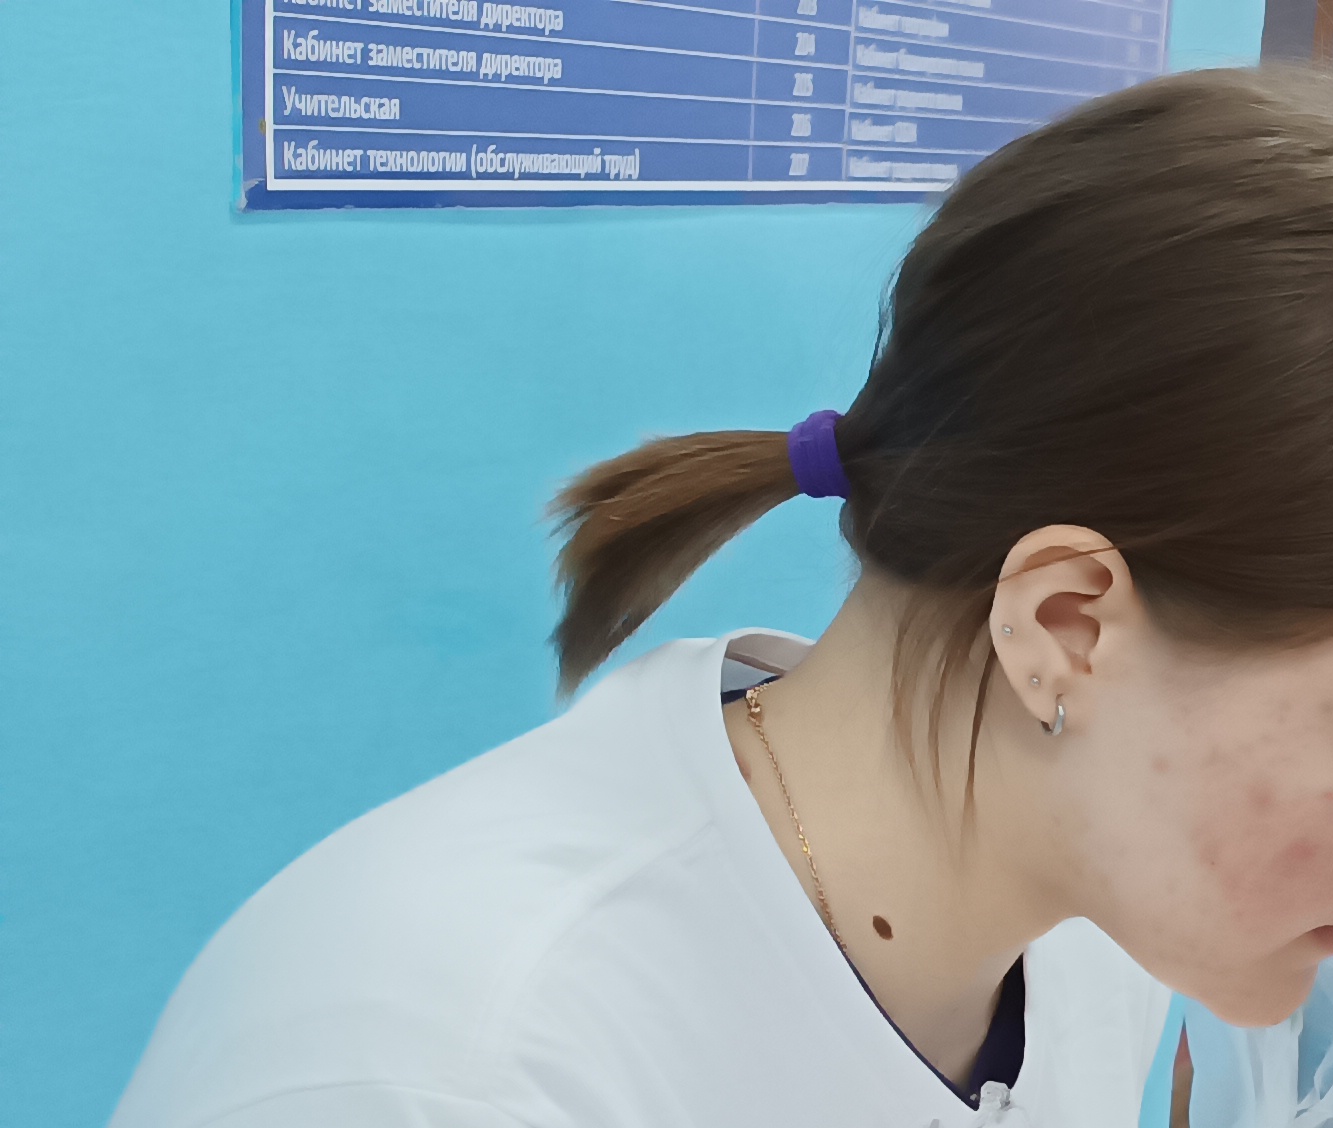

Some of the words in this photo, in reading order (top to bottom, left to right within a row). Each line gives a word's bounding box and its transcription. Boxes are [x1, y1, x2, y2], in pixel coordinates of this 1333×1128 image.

[479, 4, 564, 33] директора
[282, 29, 364, 65] Кабинет
[367, 43, 478, 73] заместителя
[479, 52, 563, 84] директора
[281, 86, 400, 120] Учительская
[282, 141, 362, 172] Кабинет
[367, 147, 467, 175] технологии
[471, 144, 602, 178] (обслуживающий
[604, 149, 641, 180] труд)
